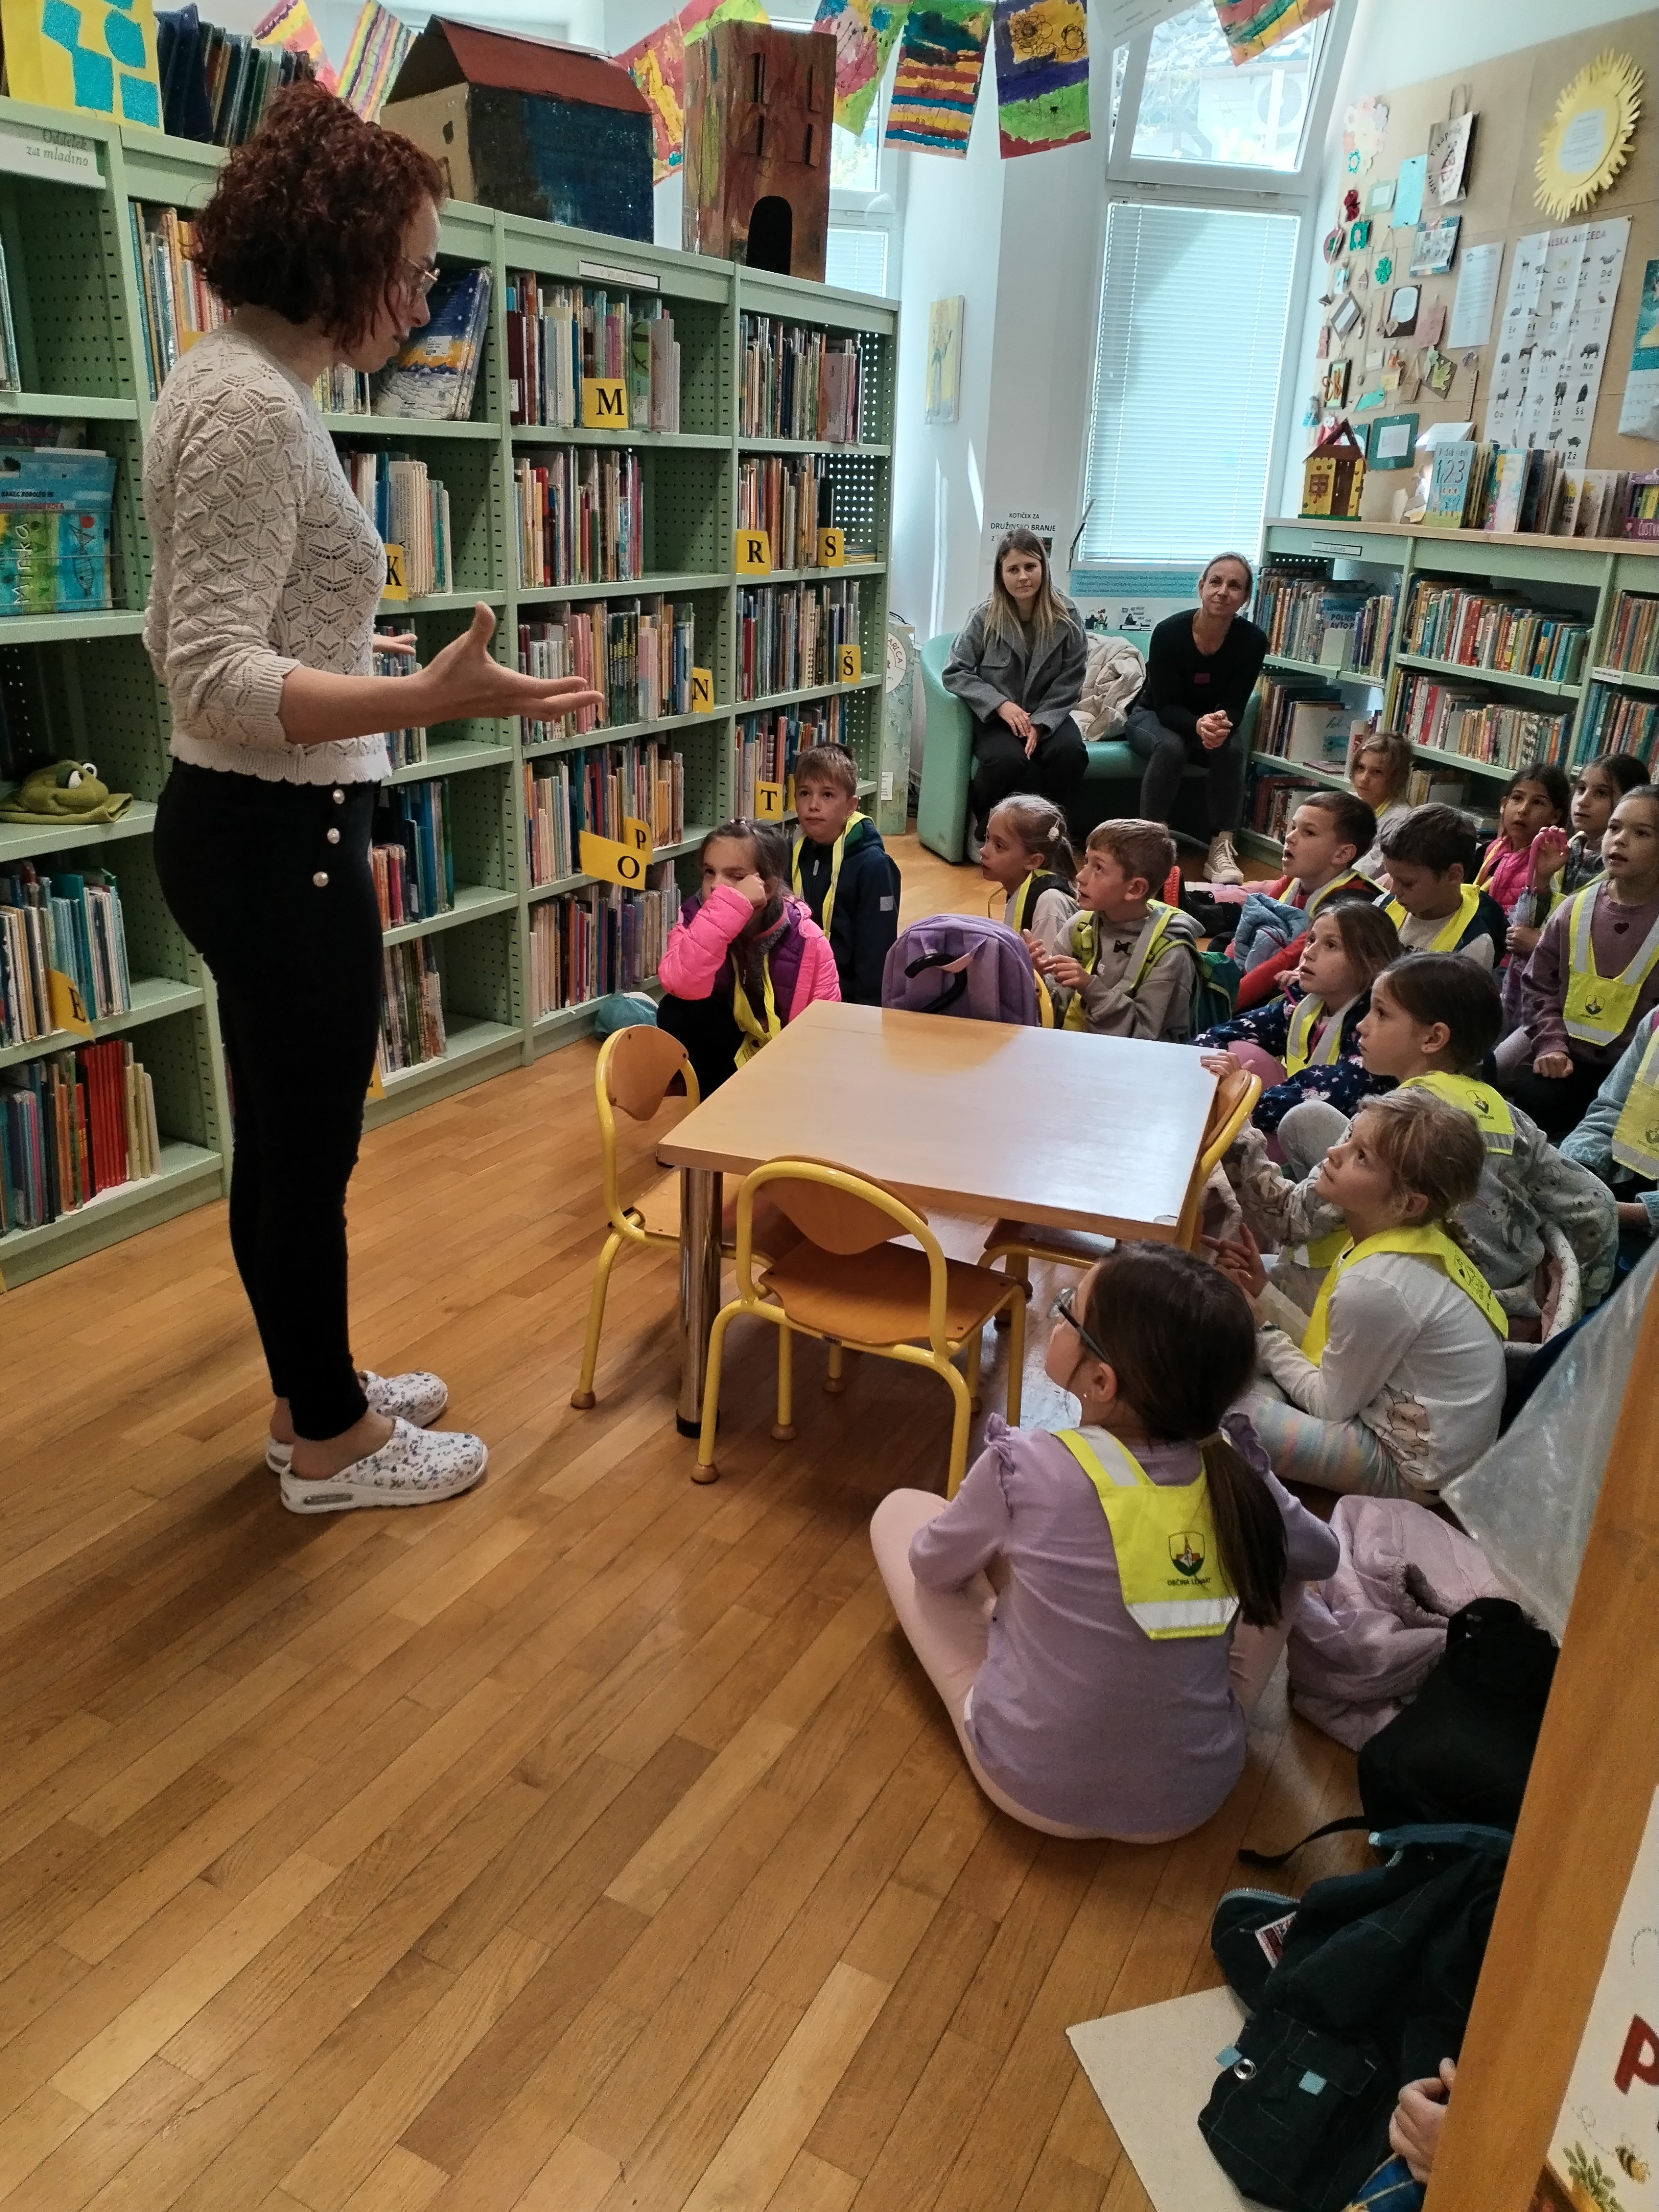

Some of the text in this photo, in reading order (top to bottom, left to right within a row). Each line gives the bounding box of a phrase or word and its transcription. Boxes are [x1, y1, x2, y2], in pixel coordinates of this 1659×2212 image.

[26, 145, 88, 166] za mladino
[1600, 269, 1612, 278] Dd
[596, 388, 625, 415] M
[990, 521, 1029, 530] DRUŽINSKO
[746, 539, 765, 563] R
[824, 536, 837, 557] S
[12, 523, 33, 604] Minka
[385, 555, 402, 587] K
[843, 650, 854, 676] Š
[692, 677, 709, 702] N
[760, 789, 778, 811] T
[634, 828, 647, 849] P
[617, 855, 640, 879] O
[68, 986, 86, 1023] E
